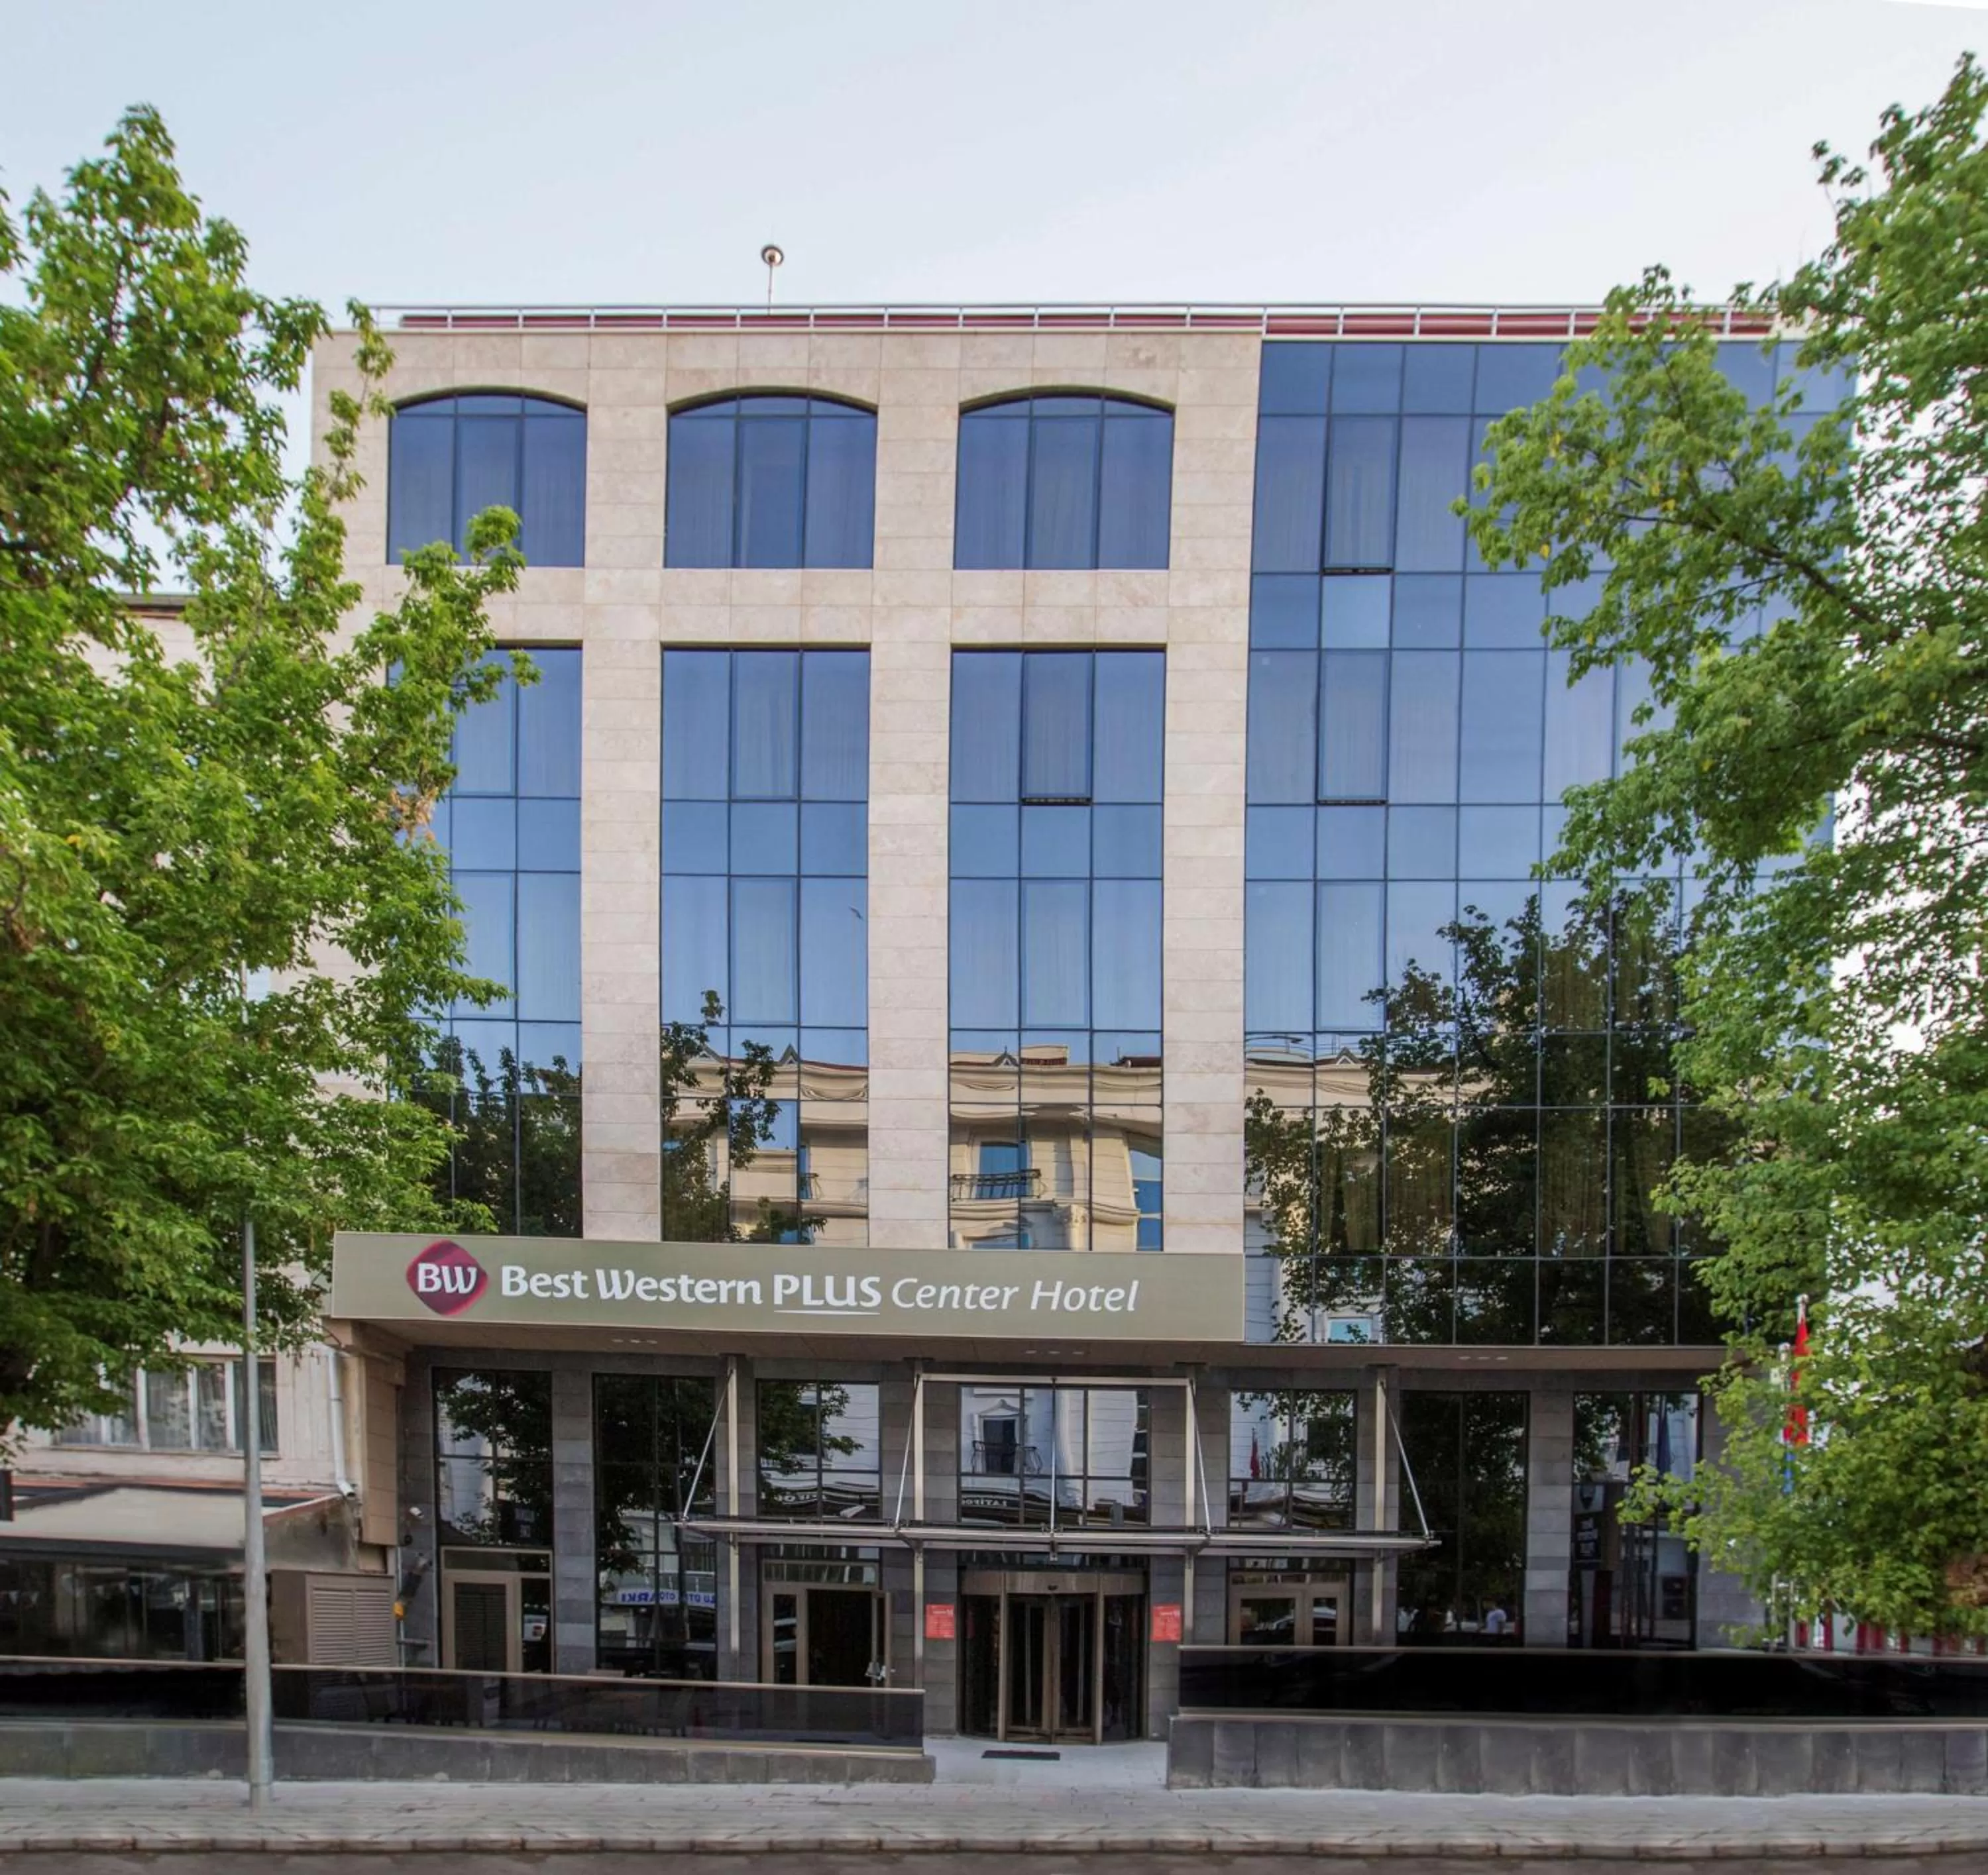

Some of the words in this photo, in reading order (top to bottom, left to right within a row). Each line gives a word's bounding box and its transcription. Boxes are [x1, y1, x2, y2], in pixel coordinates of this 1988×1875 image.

[419, 1263, 476, 1293] BW
[502, 1266, 588, 1298] Best
[596, 1269, 762, 1304] Western
[774, 1275, 881, 1307] PLUS
[892, 1278, 1019, 1310] Center
[1031, 1280, 1138, 1311] Hotel
